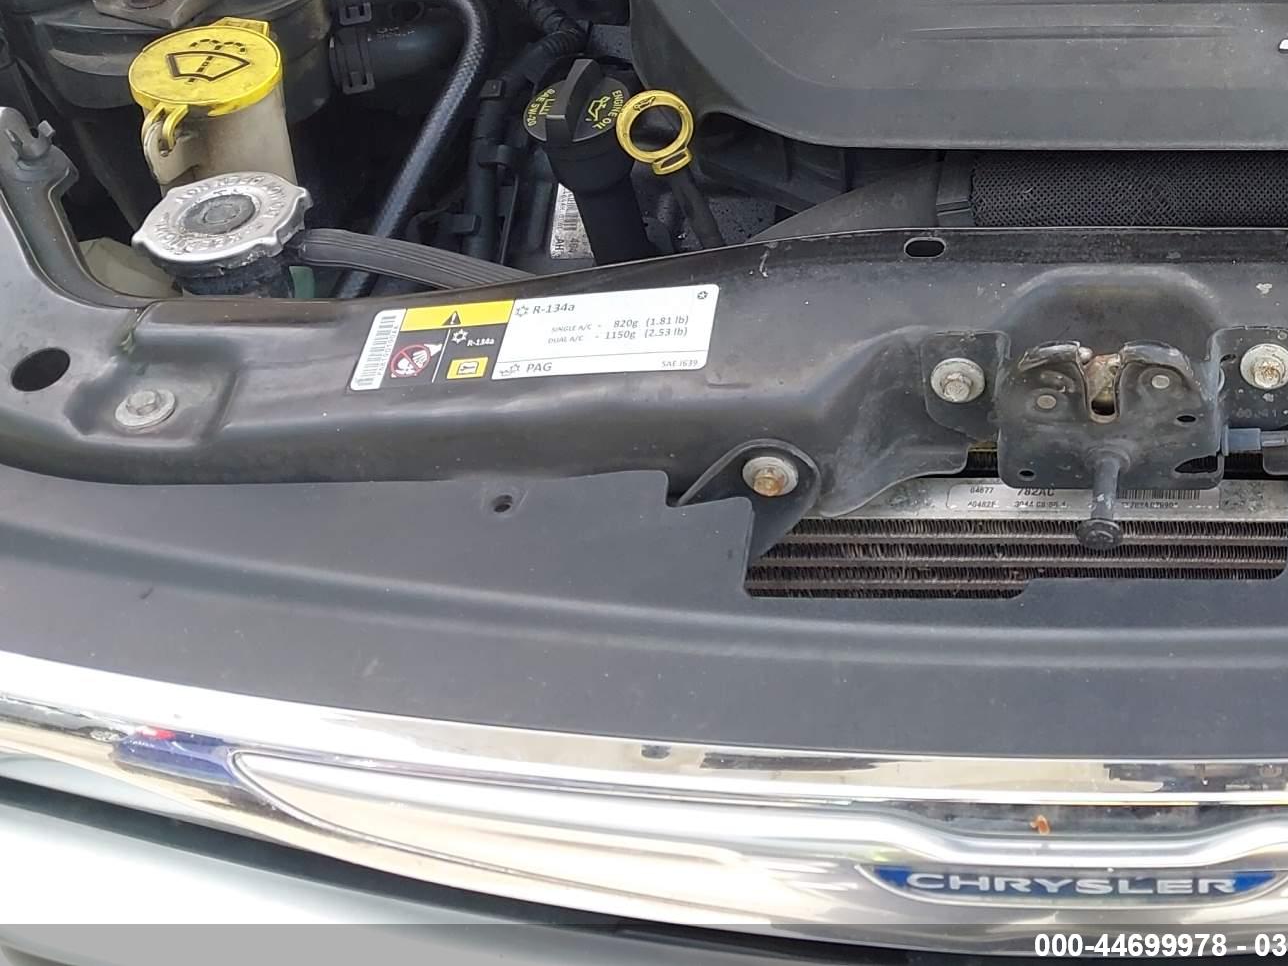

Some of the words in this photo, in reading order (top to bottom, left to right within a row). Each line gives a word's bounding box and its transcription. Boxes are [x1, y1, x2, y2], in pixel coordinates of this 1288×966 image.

[535, 88, 556, 103] SAE
[607, 89, 625, 118] ENGINE
[526, 103, 540, 127] 5W-20
[591, 117, 612, 130] OIL
[532, 302, 576, 315] R-134a
[613, 319, 639, 329] 820g
[645, 317, 672, 328] (1.81
[674, 315, 689, 326] lb)
[604, 331, 636, 341] 1150g
[644, 328, 672, 339] (2.53
[673, 327, 688, 337] lb)
[466, 338, 495, 348] R-134a
[526, 362, 553, 373] PAG
[905, 872, 1236, 894] CHRYSLER
